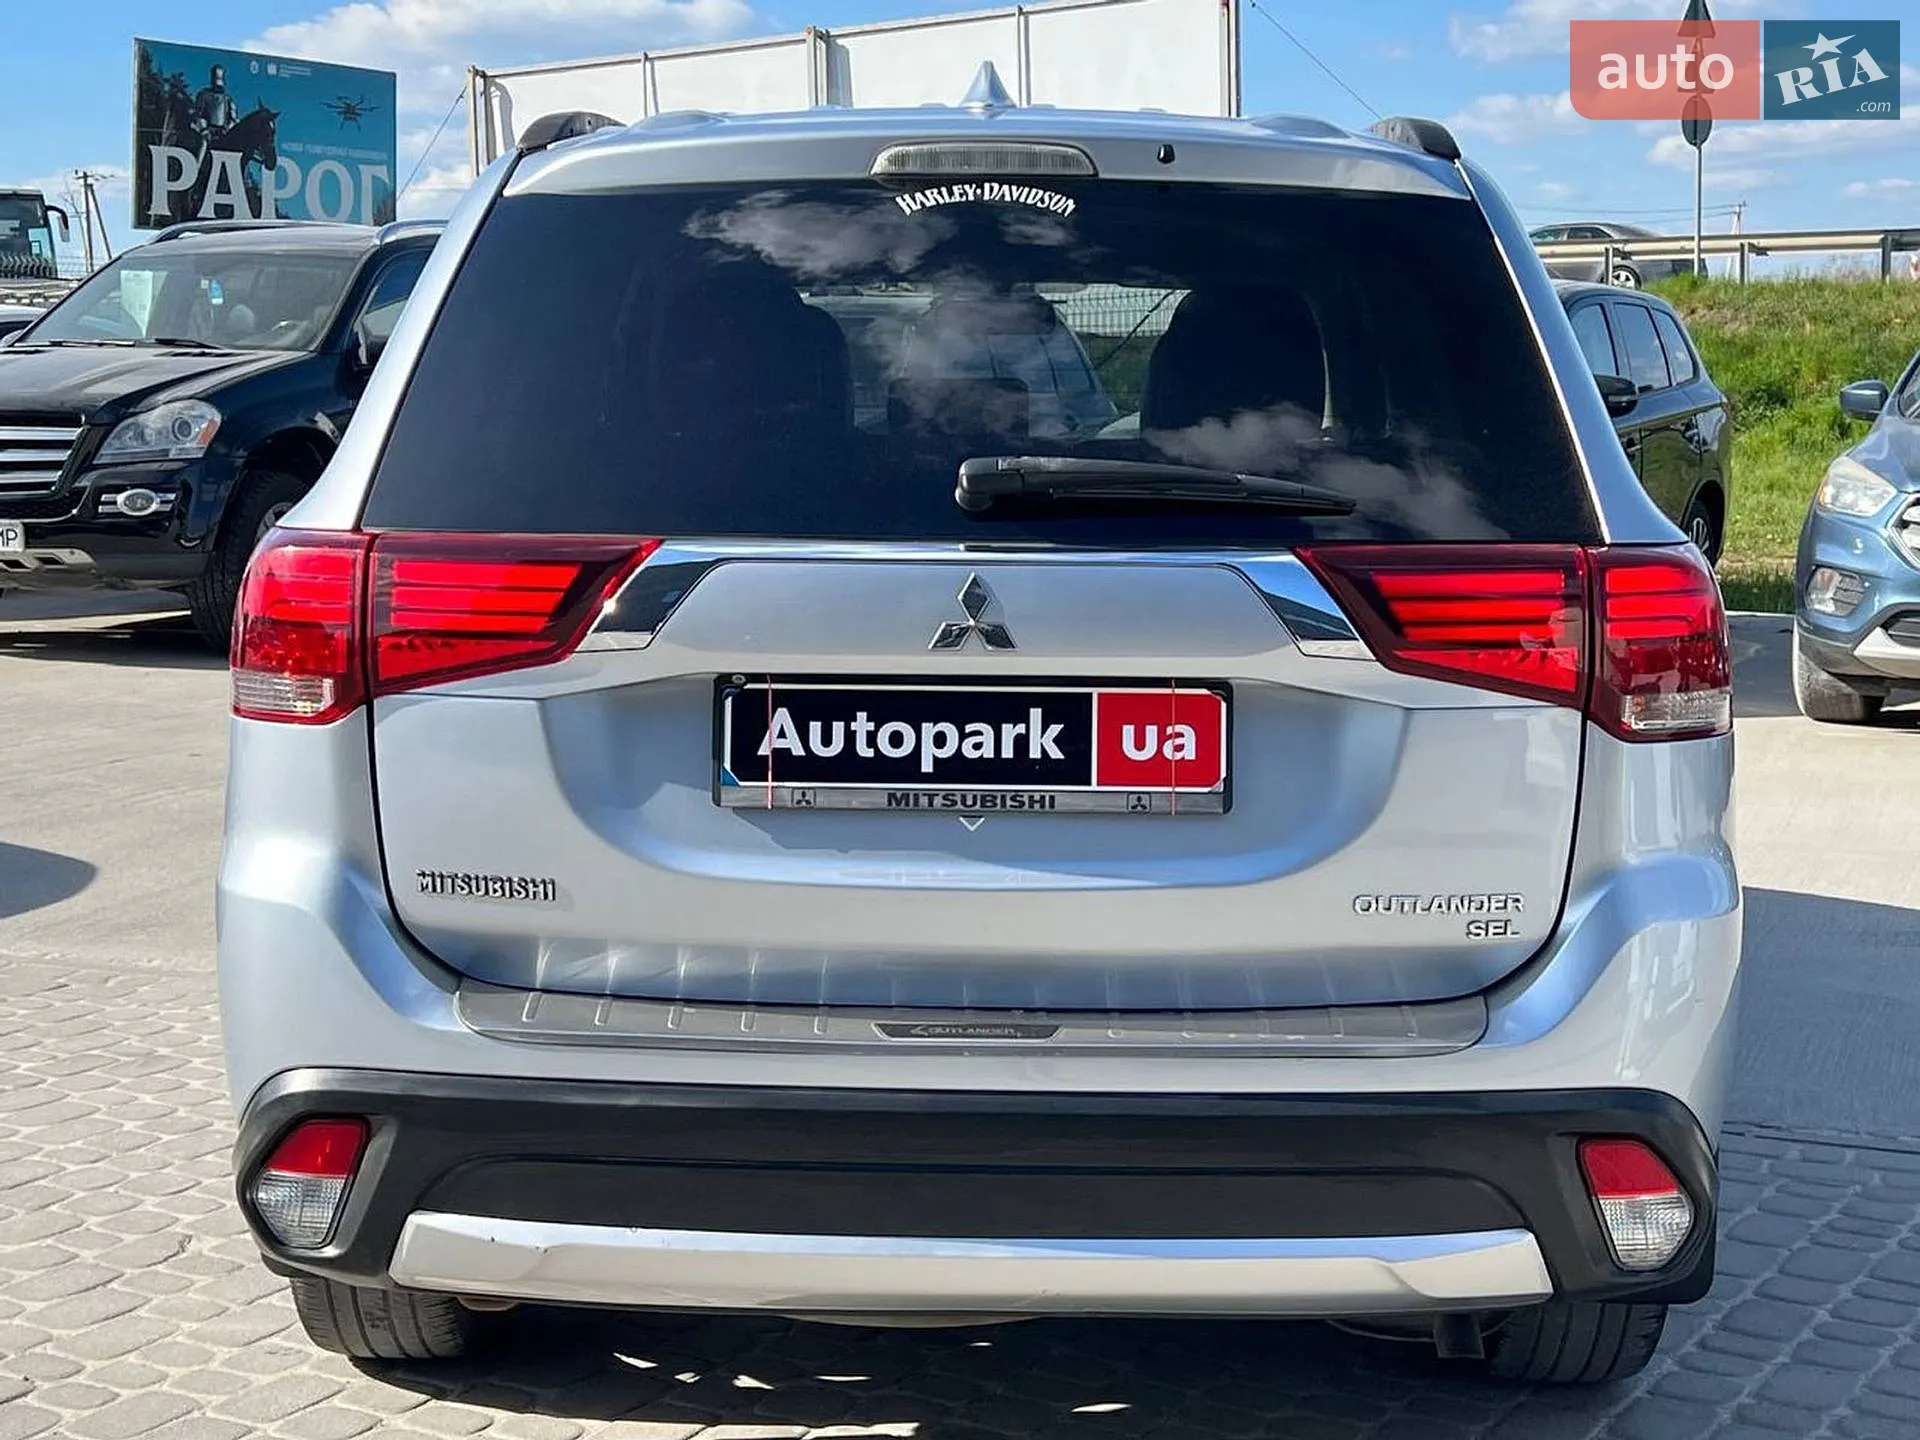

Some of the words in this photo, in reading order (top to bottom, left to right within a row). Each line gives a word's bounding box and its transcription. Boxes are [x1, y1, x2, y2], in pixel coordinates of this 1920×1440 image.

[757, 707, 1065, 773] Autopark
[1121, 723, 1197, 761] ua
[886, 792, 1056, 811] MITSUBISHI
[416, 869, 557, 901] MITSUBISHI
[1353, 893, 1525, 915] OUTLANDER
[1466, 919, 1521, 940] SEL
